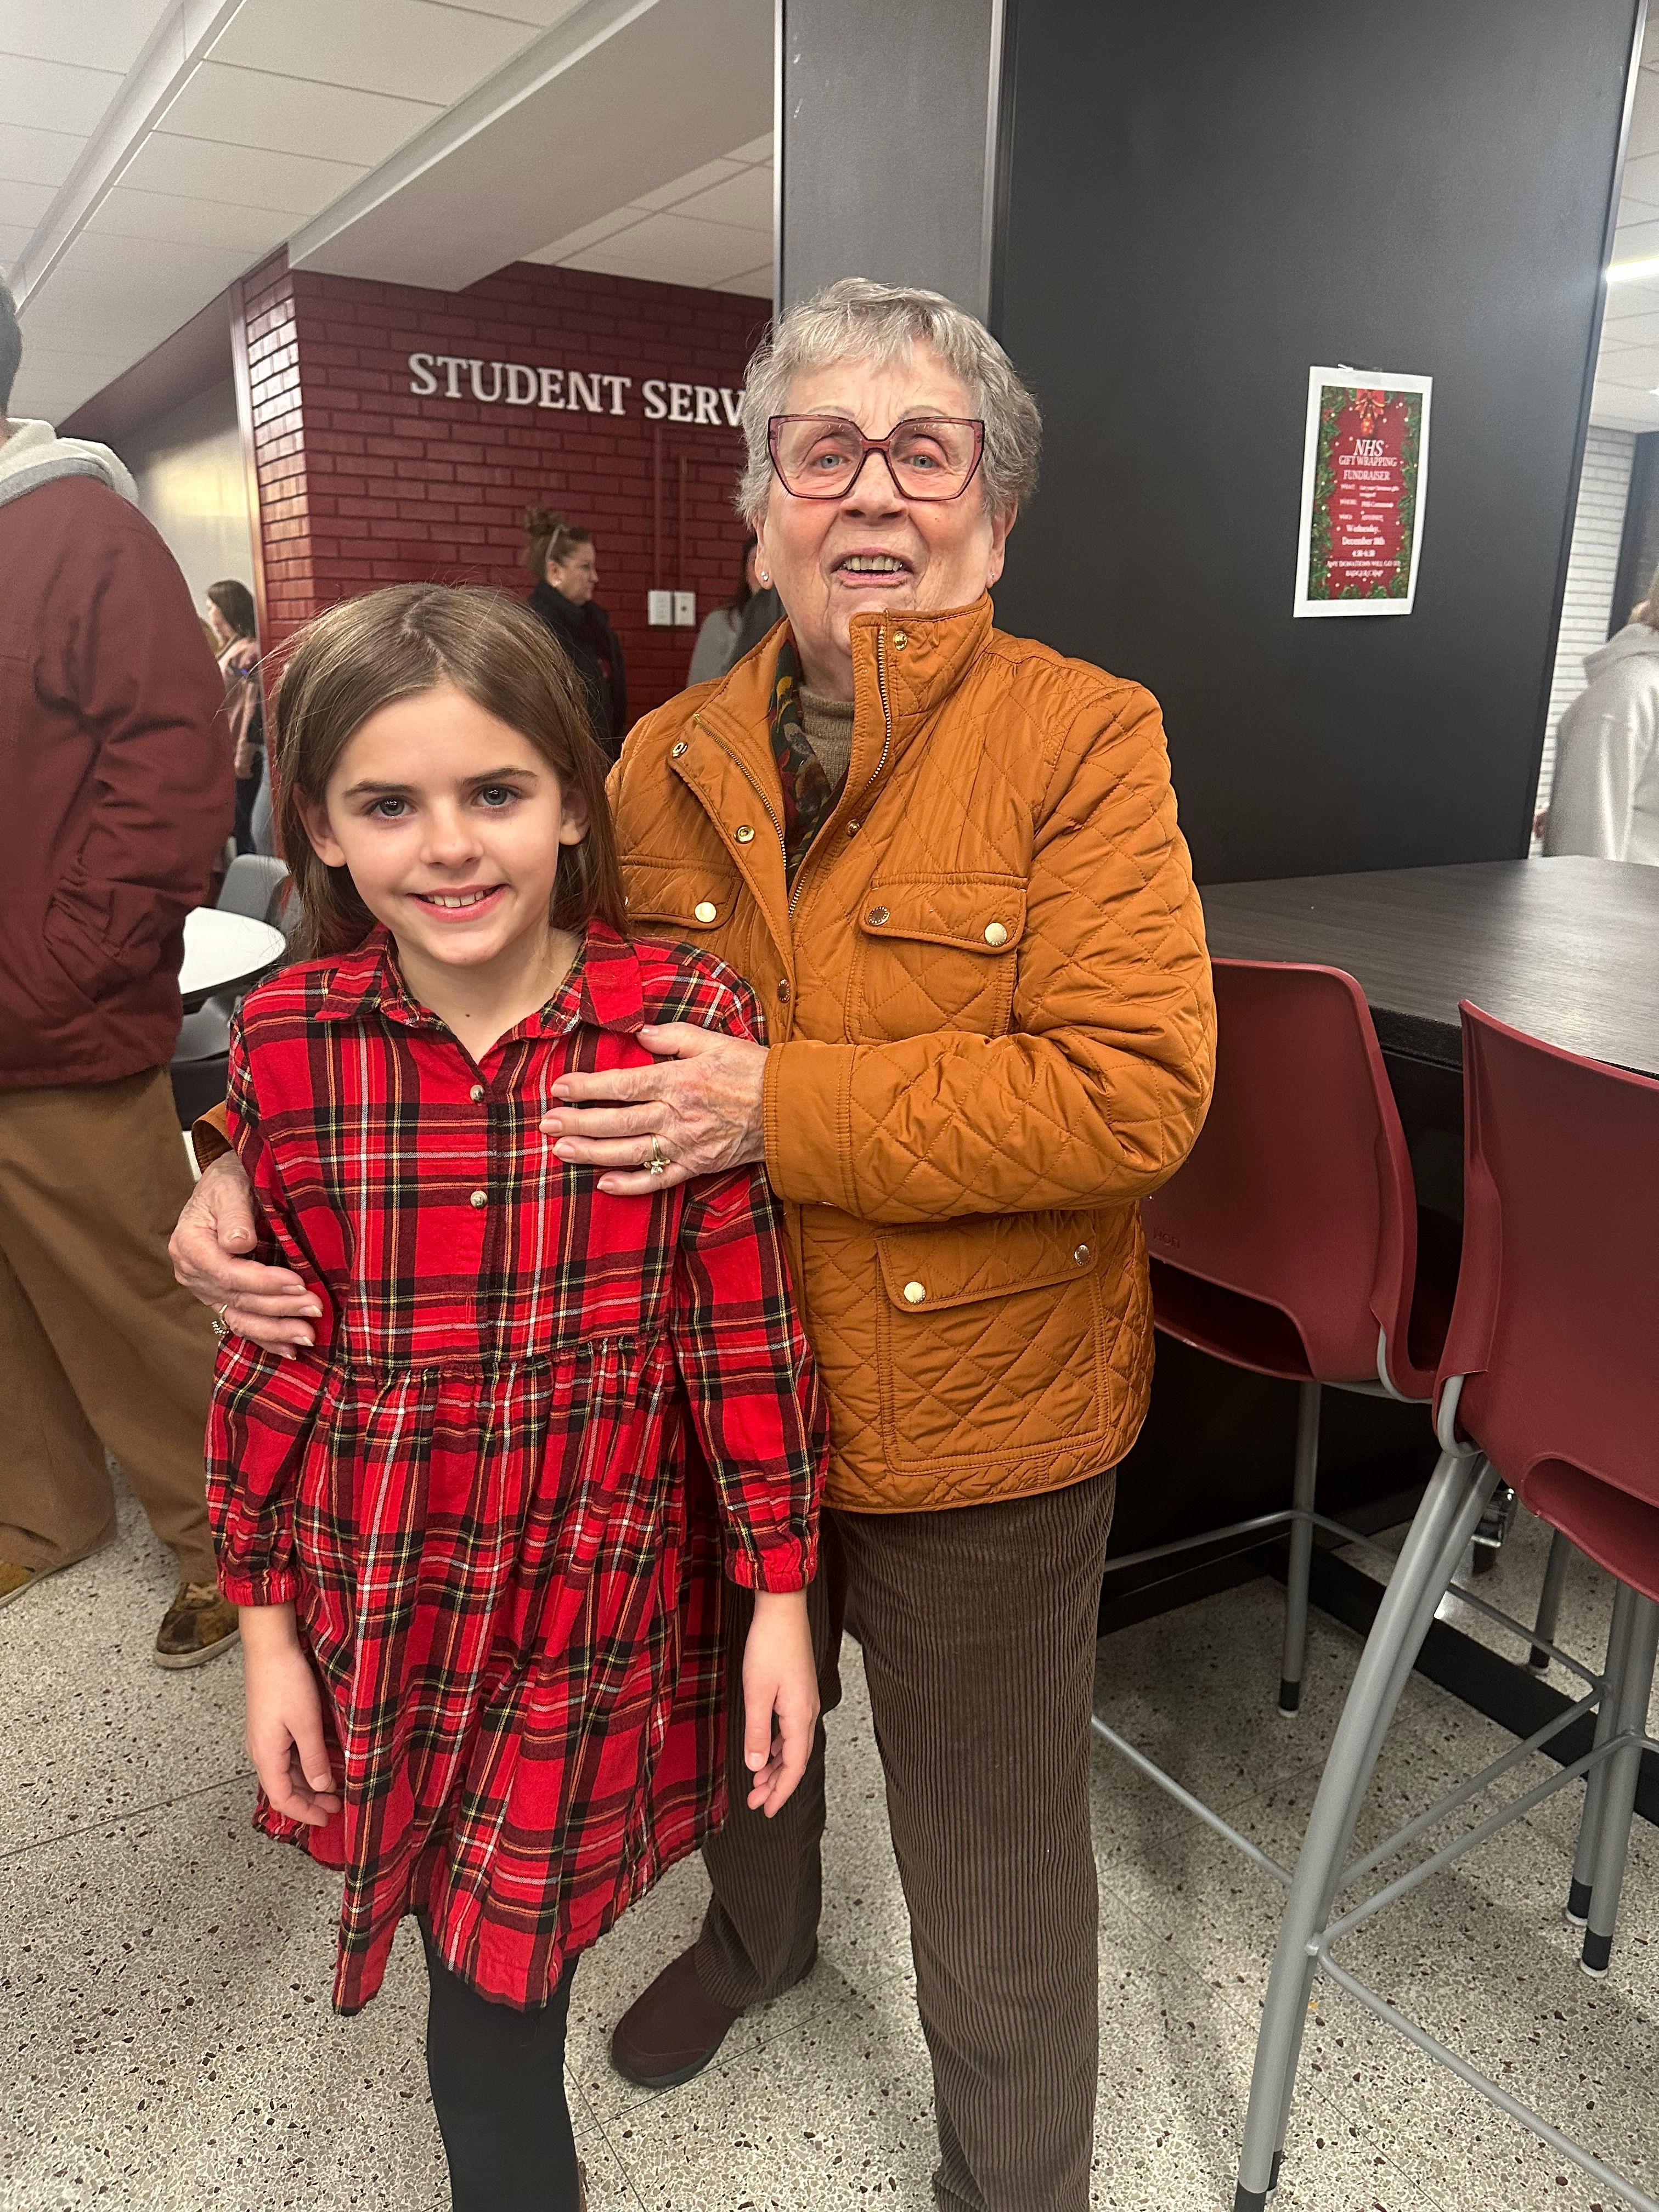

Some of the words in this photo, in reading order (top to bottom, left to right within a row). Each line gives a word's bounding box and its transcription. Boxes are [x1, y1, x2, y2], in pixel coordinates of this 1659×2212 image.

[408, 353, 631, 416] STUDENT
[1353, 439, 1384, 456] NHS
[1339, 455, 1356, 465] GIFT
[1356, 456, 1398, 466] WRAPPING
[1344, 470, 1391, 481] FUNDRAISER
[1341, 537, 1373, 545] December
